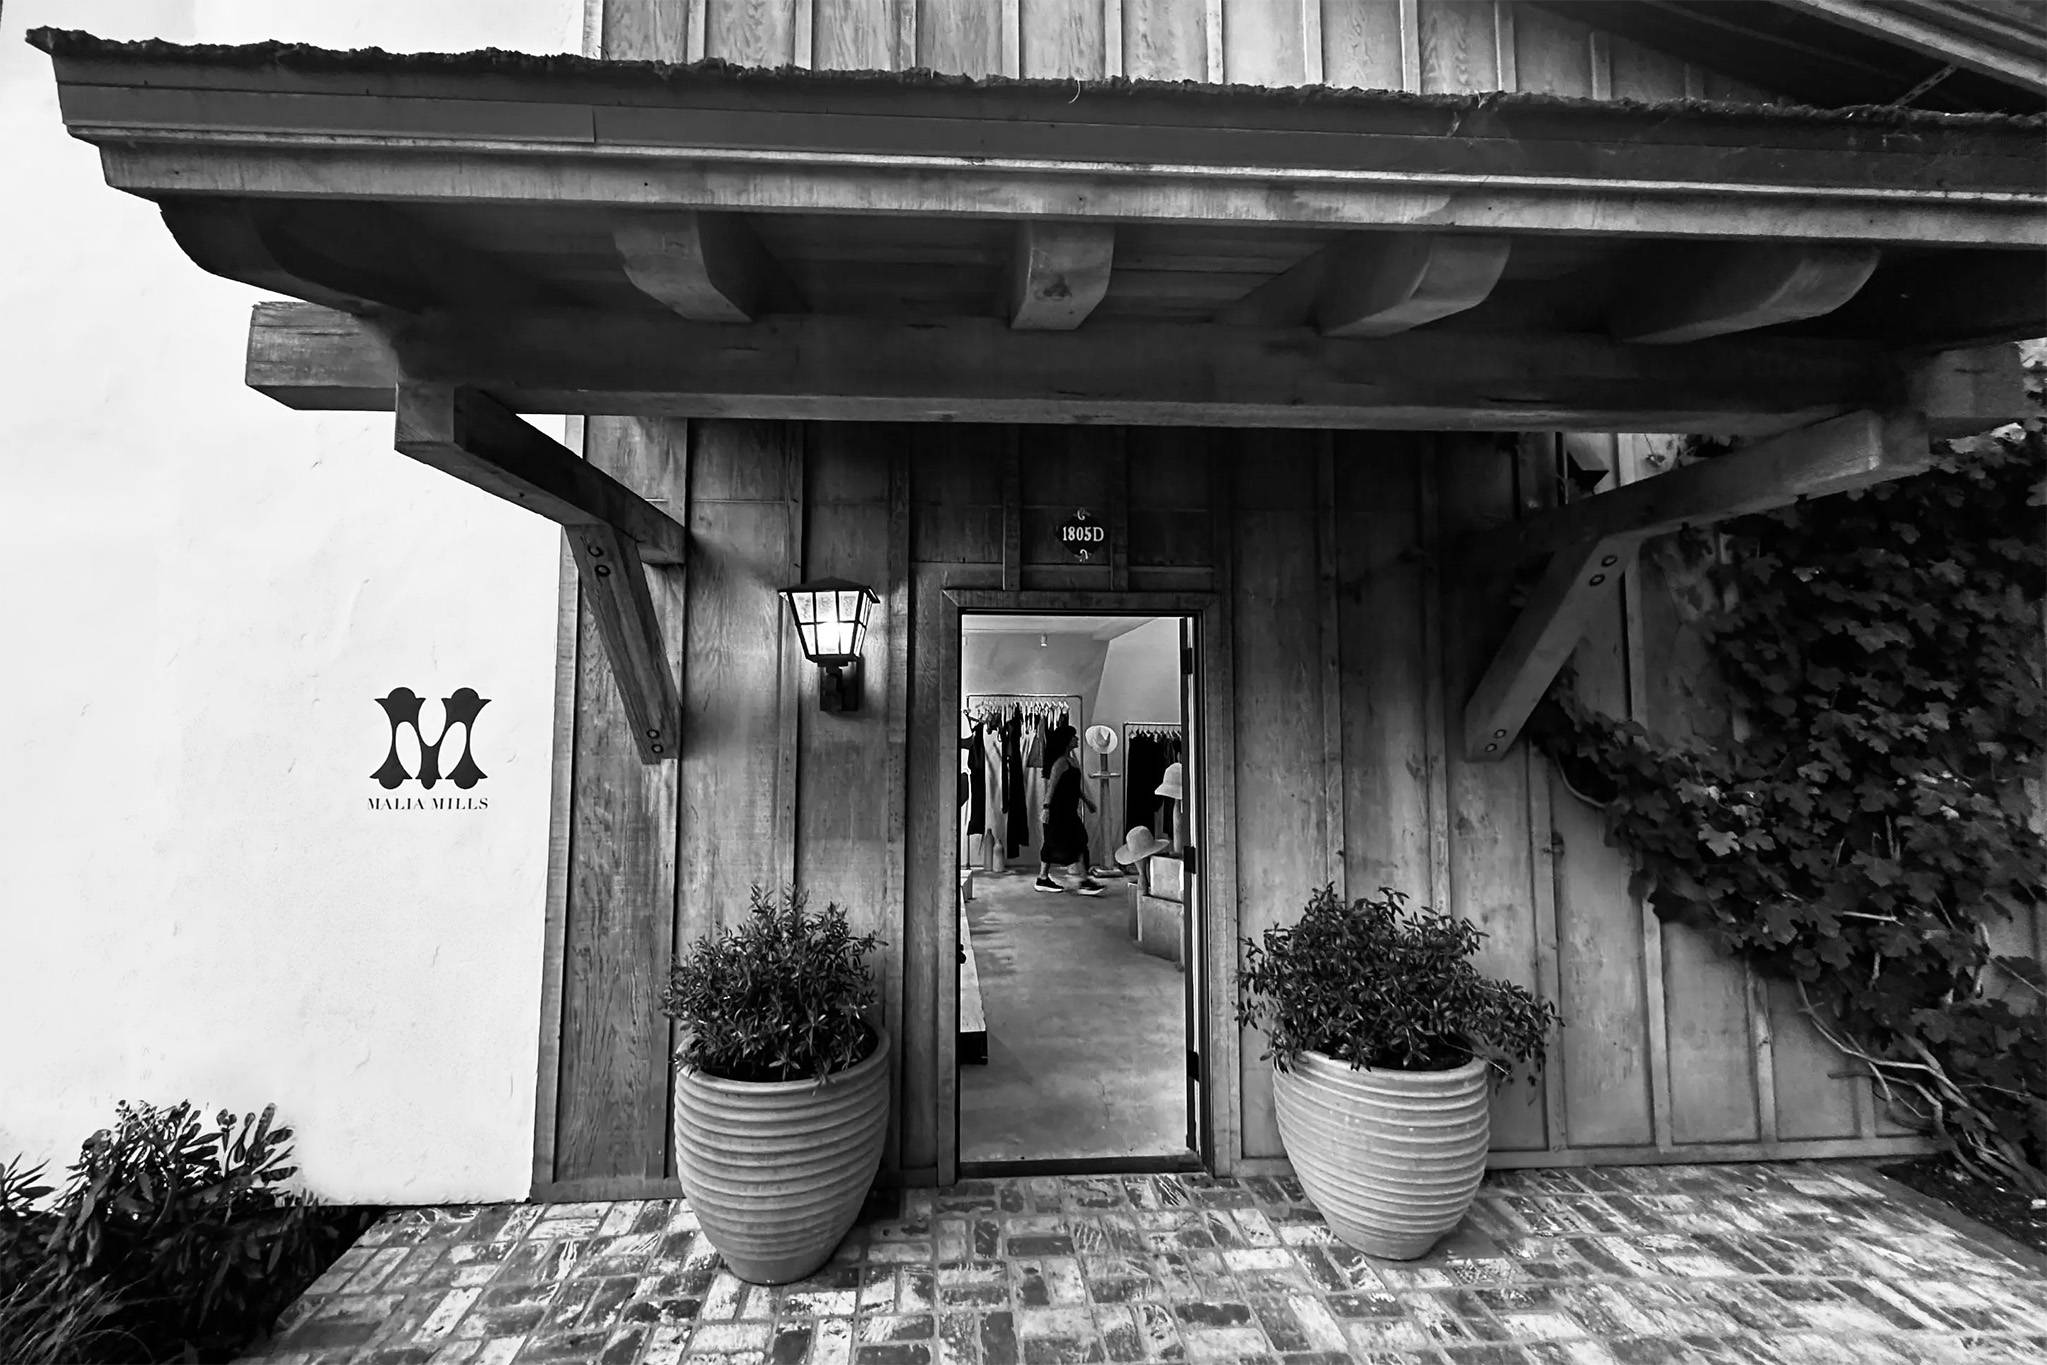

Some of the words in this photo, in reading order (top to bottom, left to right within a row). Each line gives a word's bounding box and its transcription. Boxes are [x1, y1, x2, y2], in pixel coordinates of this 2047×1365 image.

[1062, 526, 1105, 542] 1805D
[367, 797, 425, 811] MALIA
[431, 797, 489, 811] MILLS
